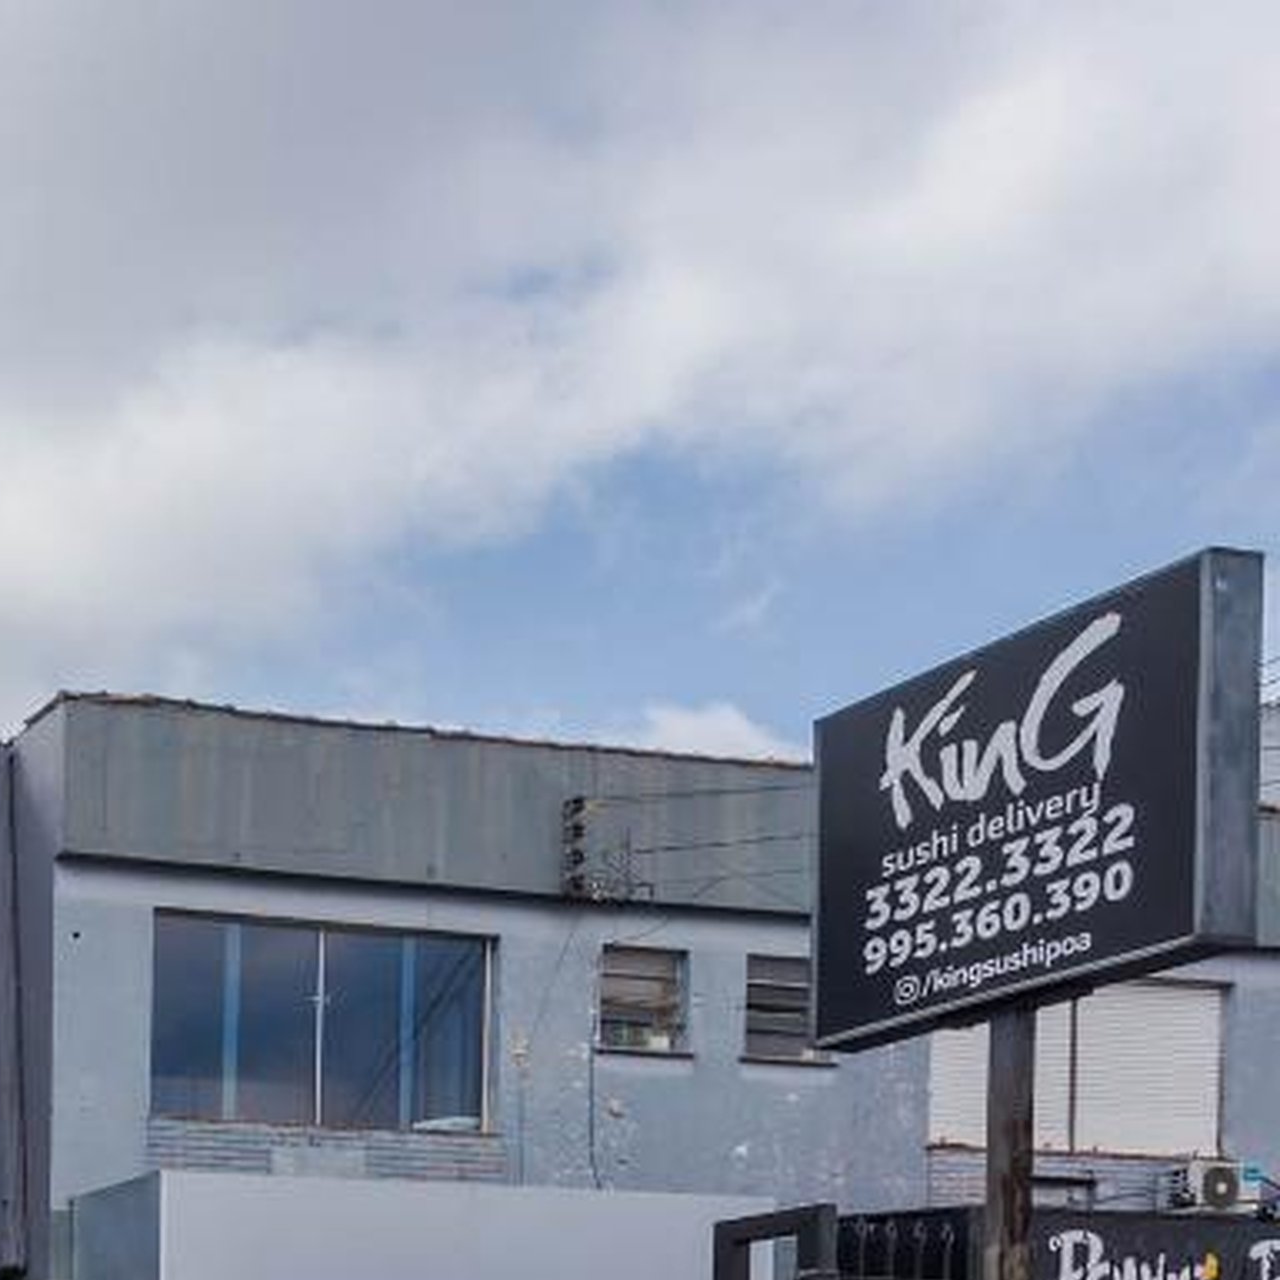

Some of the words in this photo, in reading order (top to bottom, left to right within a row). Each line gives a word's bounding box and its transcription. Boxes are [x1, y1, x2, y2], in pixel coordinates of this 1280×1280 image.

[864, 803, 1137, 932] 3322.3322
[881, 826, 958, 877] sushi
[967, 780, 1102, 849] delivery
[862, 862, 1135, 976] 995.360.390
